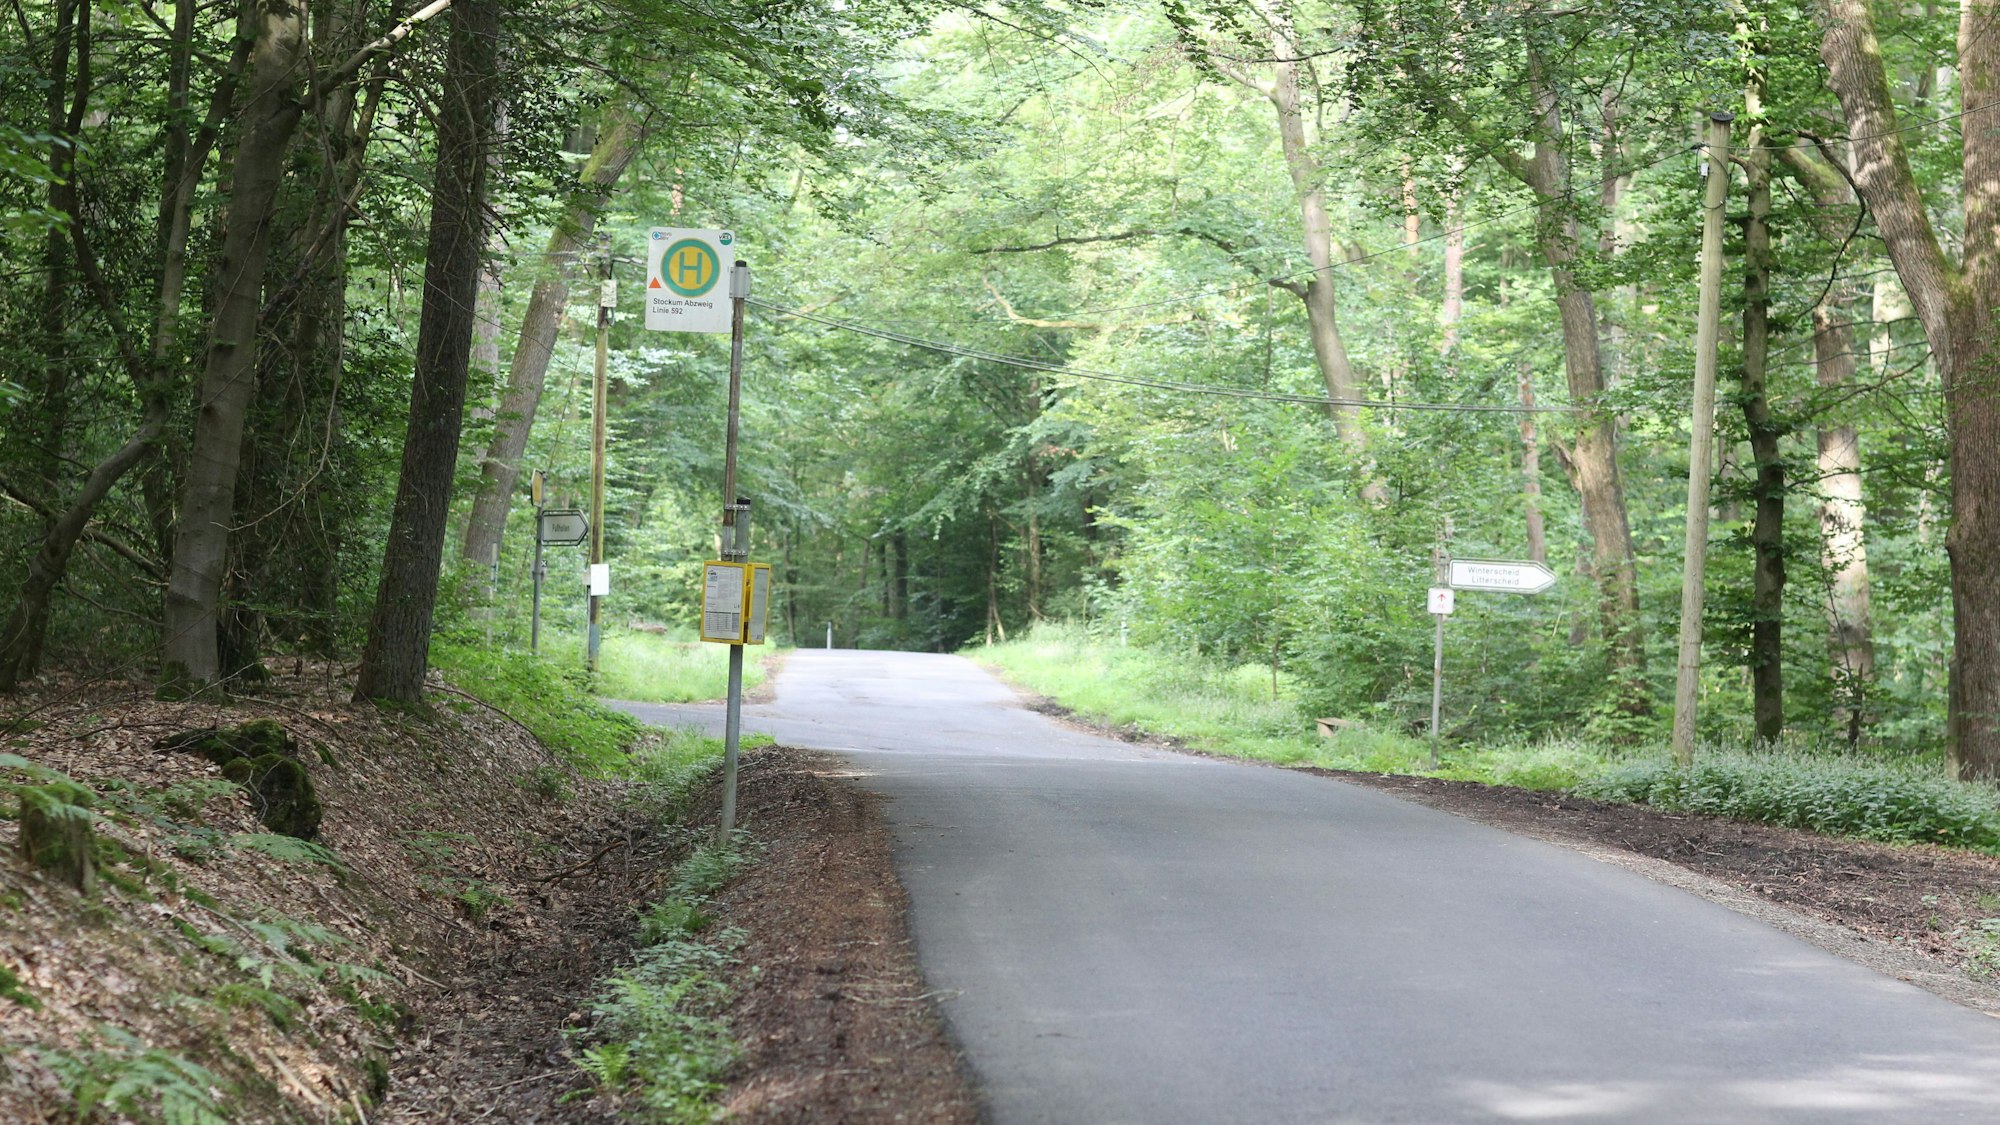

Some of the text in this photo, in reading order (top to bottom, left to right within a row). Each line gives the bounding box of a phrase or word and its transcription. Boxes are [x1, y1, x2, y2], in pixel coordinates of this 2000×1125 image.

[678, 251, 703, 285] H
[653, 297, 713, 309] Stockum Abzweig
[652, 306, 683, 315] Linie 592
[1468, 566, 1520, 576] Winterscheid
[1471, 576, 1520, 586] Litterscheid
